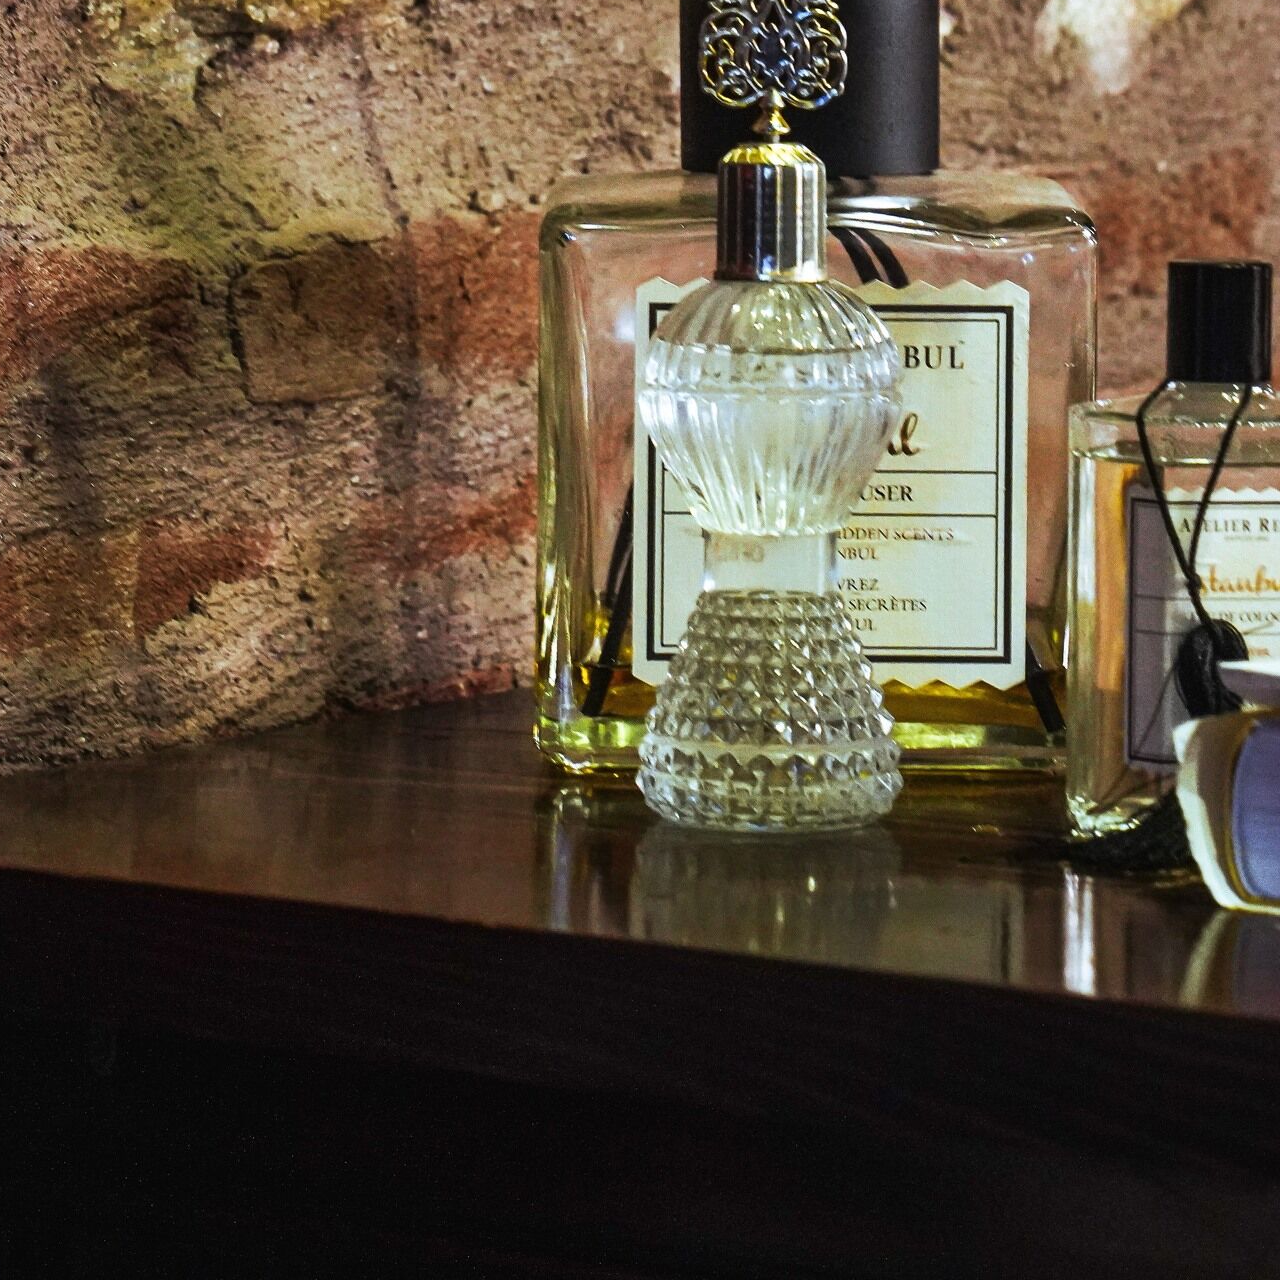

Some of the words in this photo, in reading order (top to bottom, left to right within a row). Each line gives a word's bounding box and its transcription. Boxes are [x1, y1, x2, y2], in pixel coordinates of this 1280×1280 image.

[903, 345, 964, 370] BUL
[860, 485, 914, 502] USER
[1178, 518, 1251, 533] AELIER
[838, 527, 889, 540] IDDEN
[894, 528, 955, 541] SCENTS
[838, 547, 879, 560] NBUL
[848, 594, 928, 611] SECRÈTES
